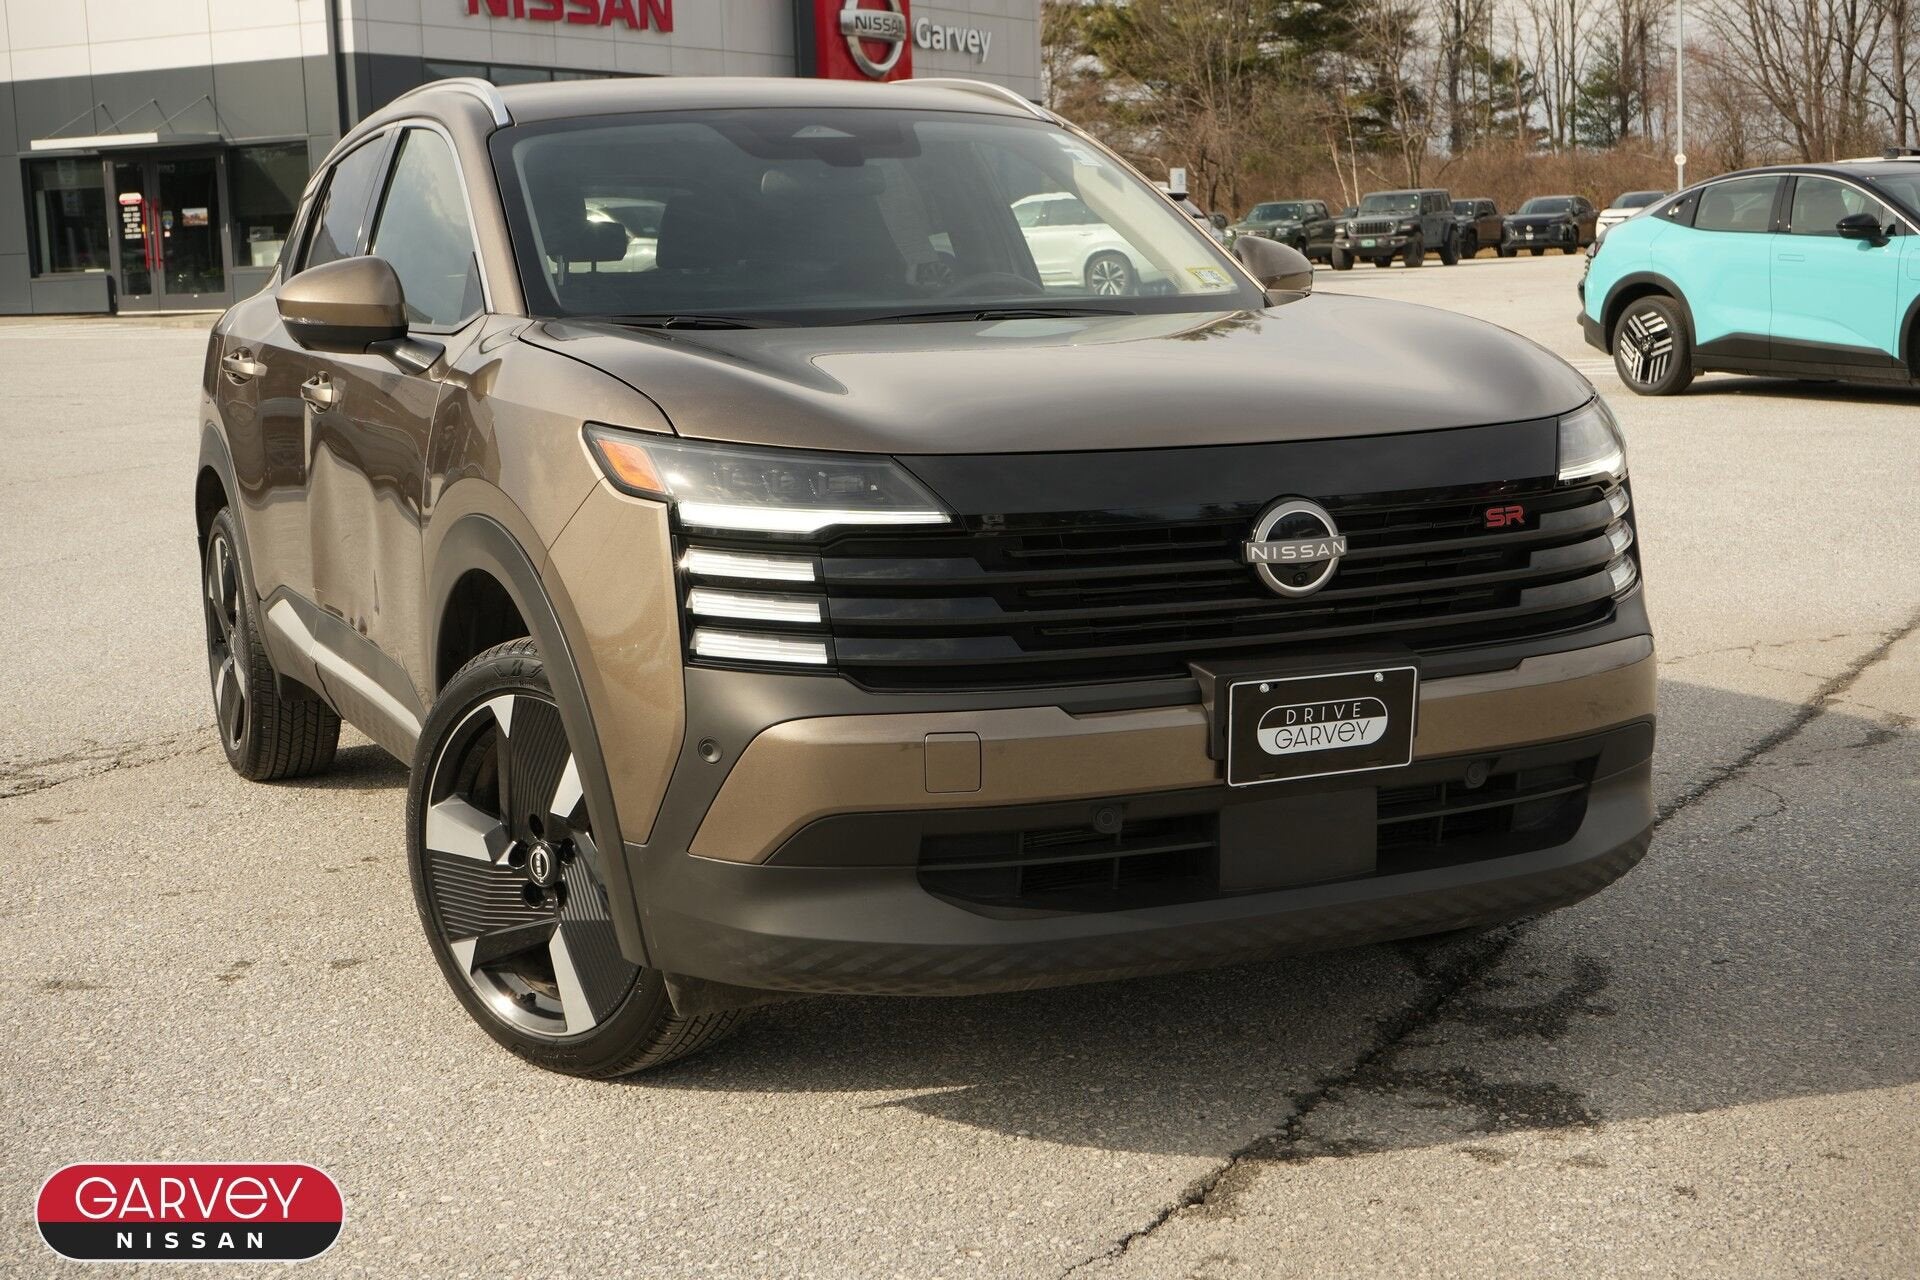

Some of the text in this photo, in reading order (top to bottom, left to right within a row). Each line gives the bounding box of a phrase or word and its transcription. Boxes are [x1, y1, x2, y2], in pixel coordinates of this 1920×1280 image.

[915, 17, 992, 63] Garvey
[1486, 506, 1525, 527] SR
[1251, 540, 1345, 560] NISSAN
[1286, 702, 1362, 725] DRIVE
